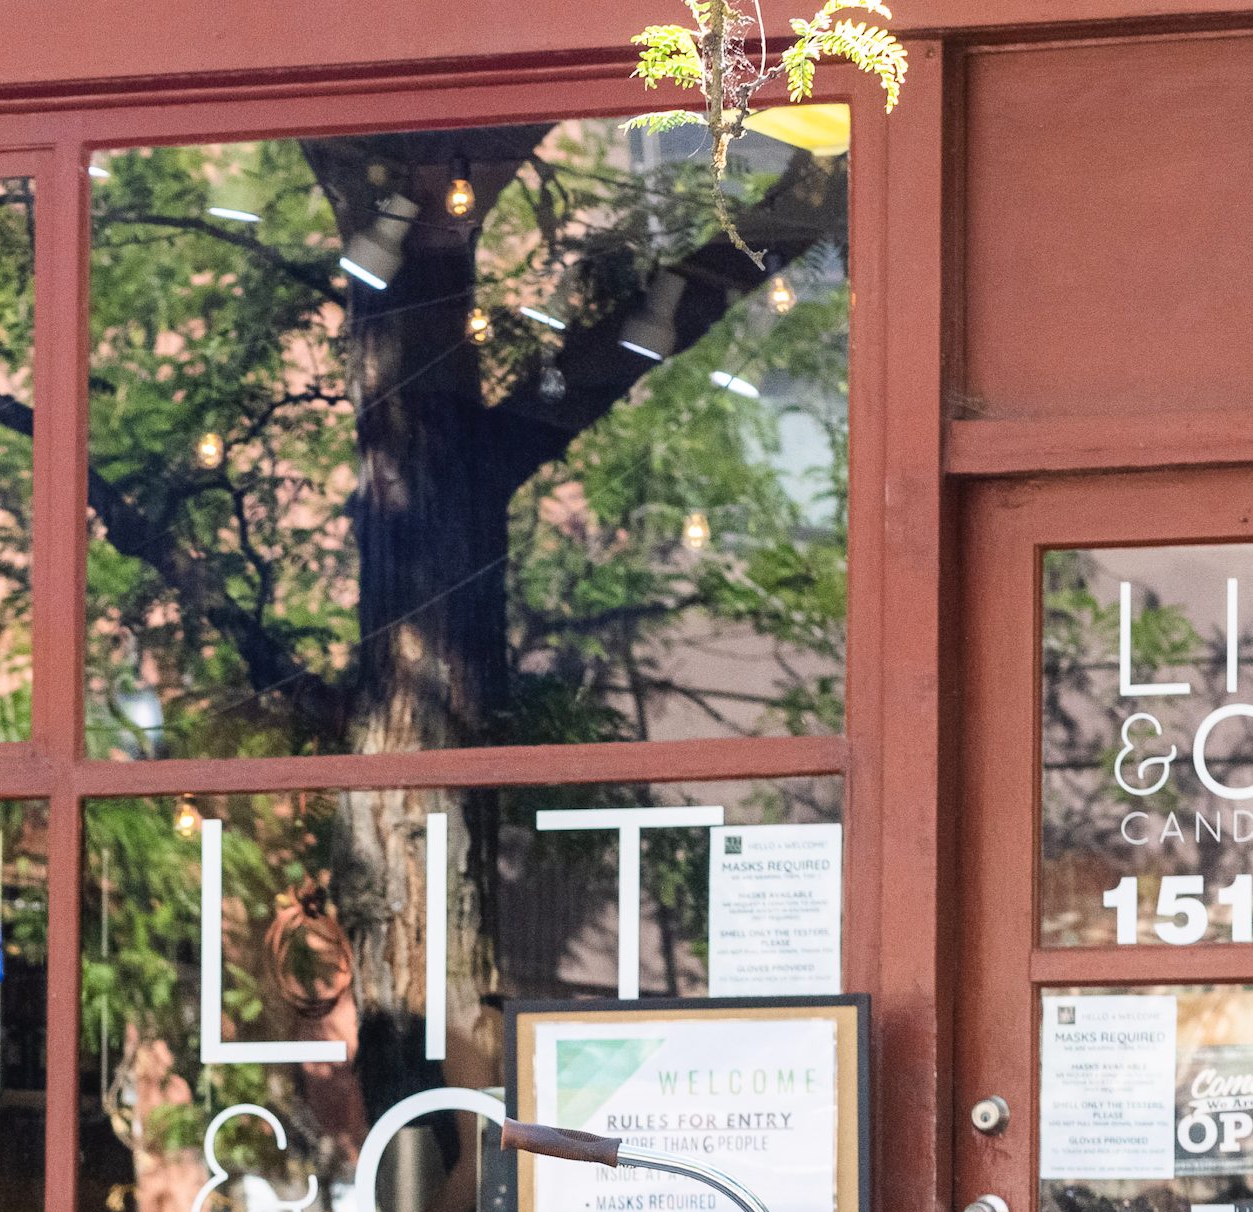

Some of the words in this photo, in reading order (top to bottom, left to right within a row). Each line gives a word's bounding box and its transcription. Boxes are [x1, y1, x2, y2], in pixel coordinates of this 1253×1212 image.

[722, 861, 764, 872] MASKS
[767, 859, 831, 873] REQUIRED
[1103, 873, 1253, 945] 151
[200, 805, 725, 1064] LIT
[1055, 1031, 1098, 1043] MASKS
[1100, 1031, 1166, 1045] REQUIRED
[658, 1068, 817, 1096] WELCOME
[607, 1113, 669, 1130] RULES
[678, 1113, 717, 1129] FOR
[726, 1112, 793, 1129] ENTRY
[1177, 1112, 1253, 1154] OP
[663, 1136, 698, 1152] THAN
[703, 1135, 715, 1154] 6
[718, 1135, 768, 1152] PEOPLE
[596, 1196, 644, 1211] MASKS
[648, 1193, 717, 1210] REQUIRED
